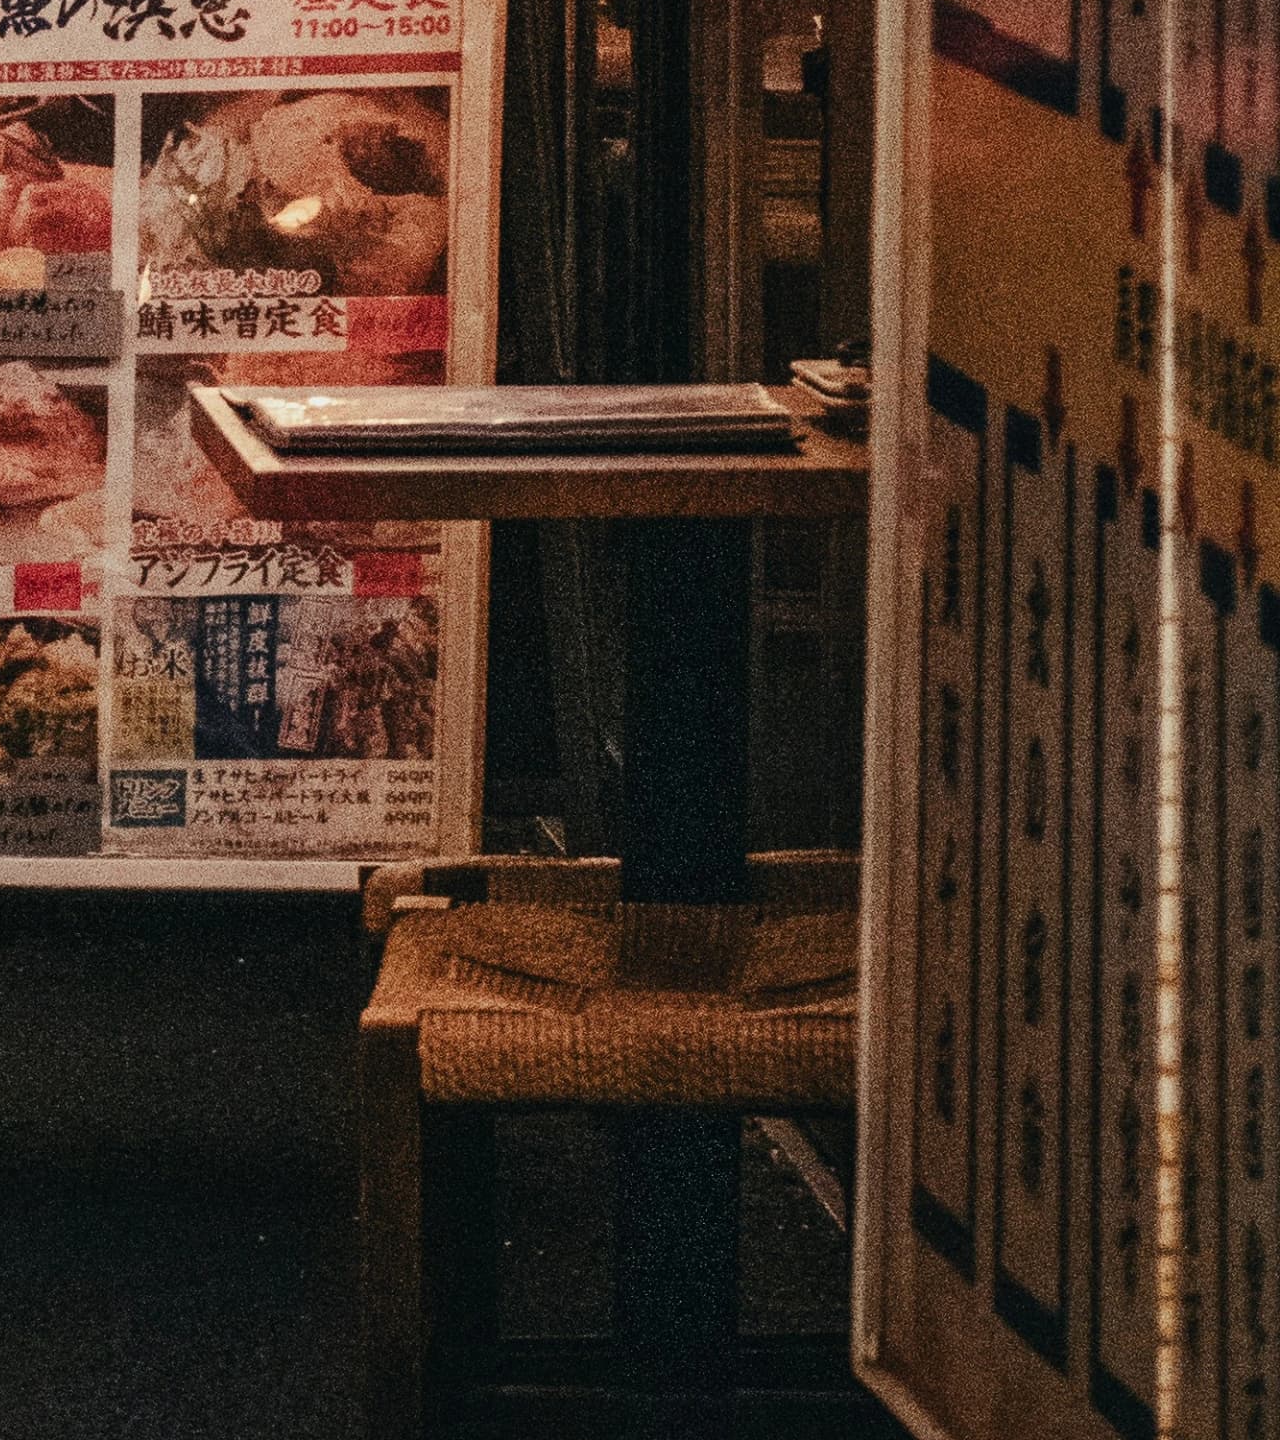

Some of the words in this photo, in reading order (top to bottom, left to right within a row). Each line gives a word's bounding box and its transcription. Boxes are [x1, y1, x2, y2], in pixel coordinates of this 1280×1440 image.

[136, 298, 348, 341] 鯖味噌定食
[130, 546, 345, 588] アジフライ定食
